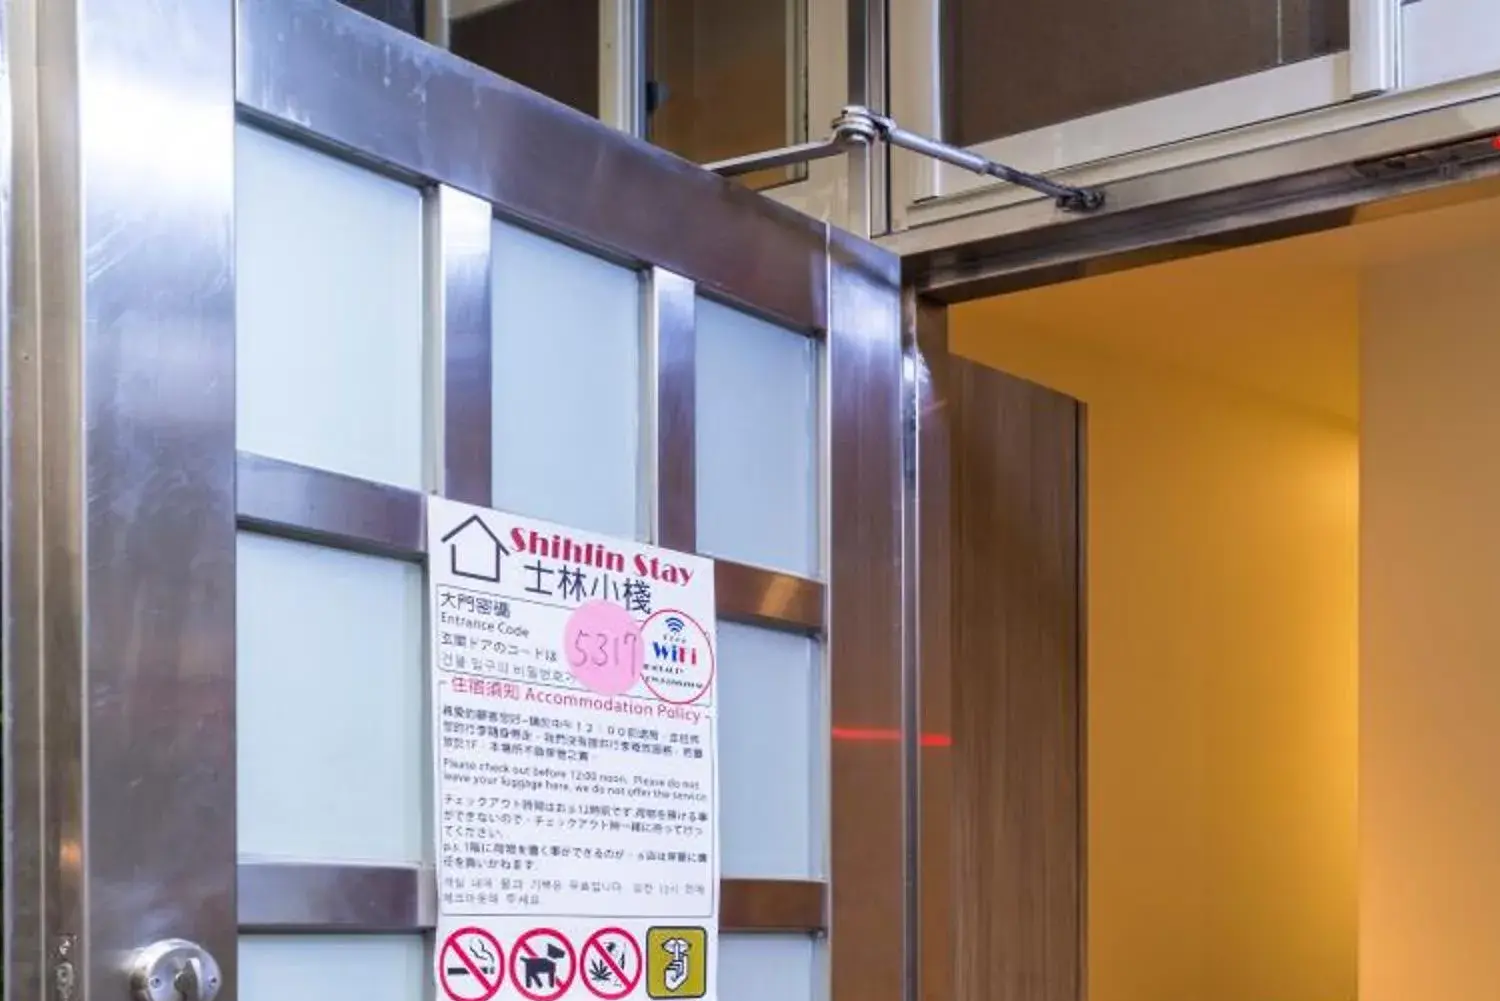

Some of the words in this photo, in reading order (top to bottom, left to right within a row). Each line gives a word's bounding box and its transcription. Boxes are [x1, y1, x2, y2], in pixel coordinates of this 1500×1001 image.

[510, 526, 625, 573] Shihlin
[633, 553, 695, 587] Stay
[441, 611, 495, 631] Entrance
[497, 621, 530, 638] Code
[525, 687, 653, 715] Accommodation
[657, 703, 701, 725] Policy
